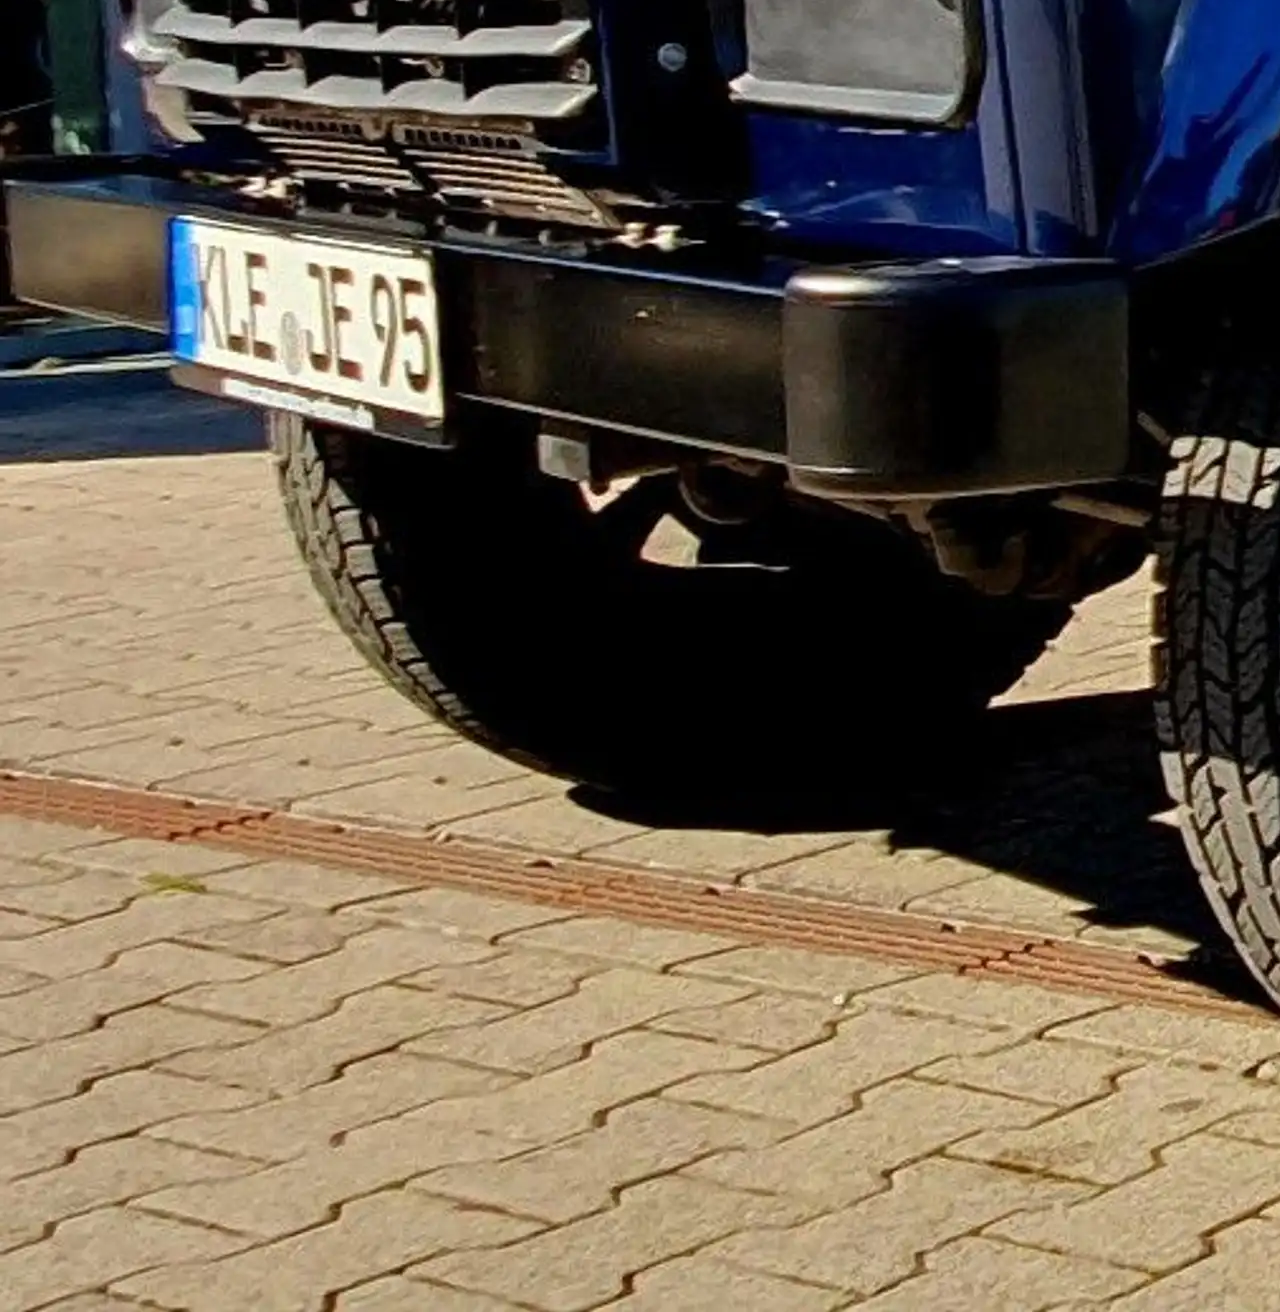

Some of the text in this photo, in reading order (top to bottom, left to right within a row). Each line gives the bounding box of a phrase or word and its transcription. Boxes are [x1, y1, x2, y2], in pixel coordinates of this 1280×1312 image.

[193, 243, 432, 393] KLE JE 95
